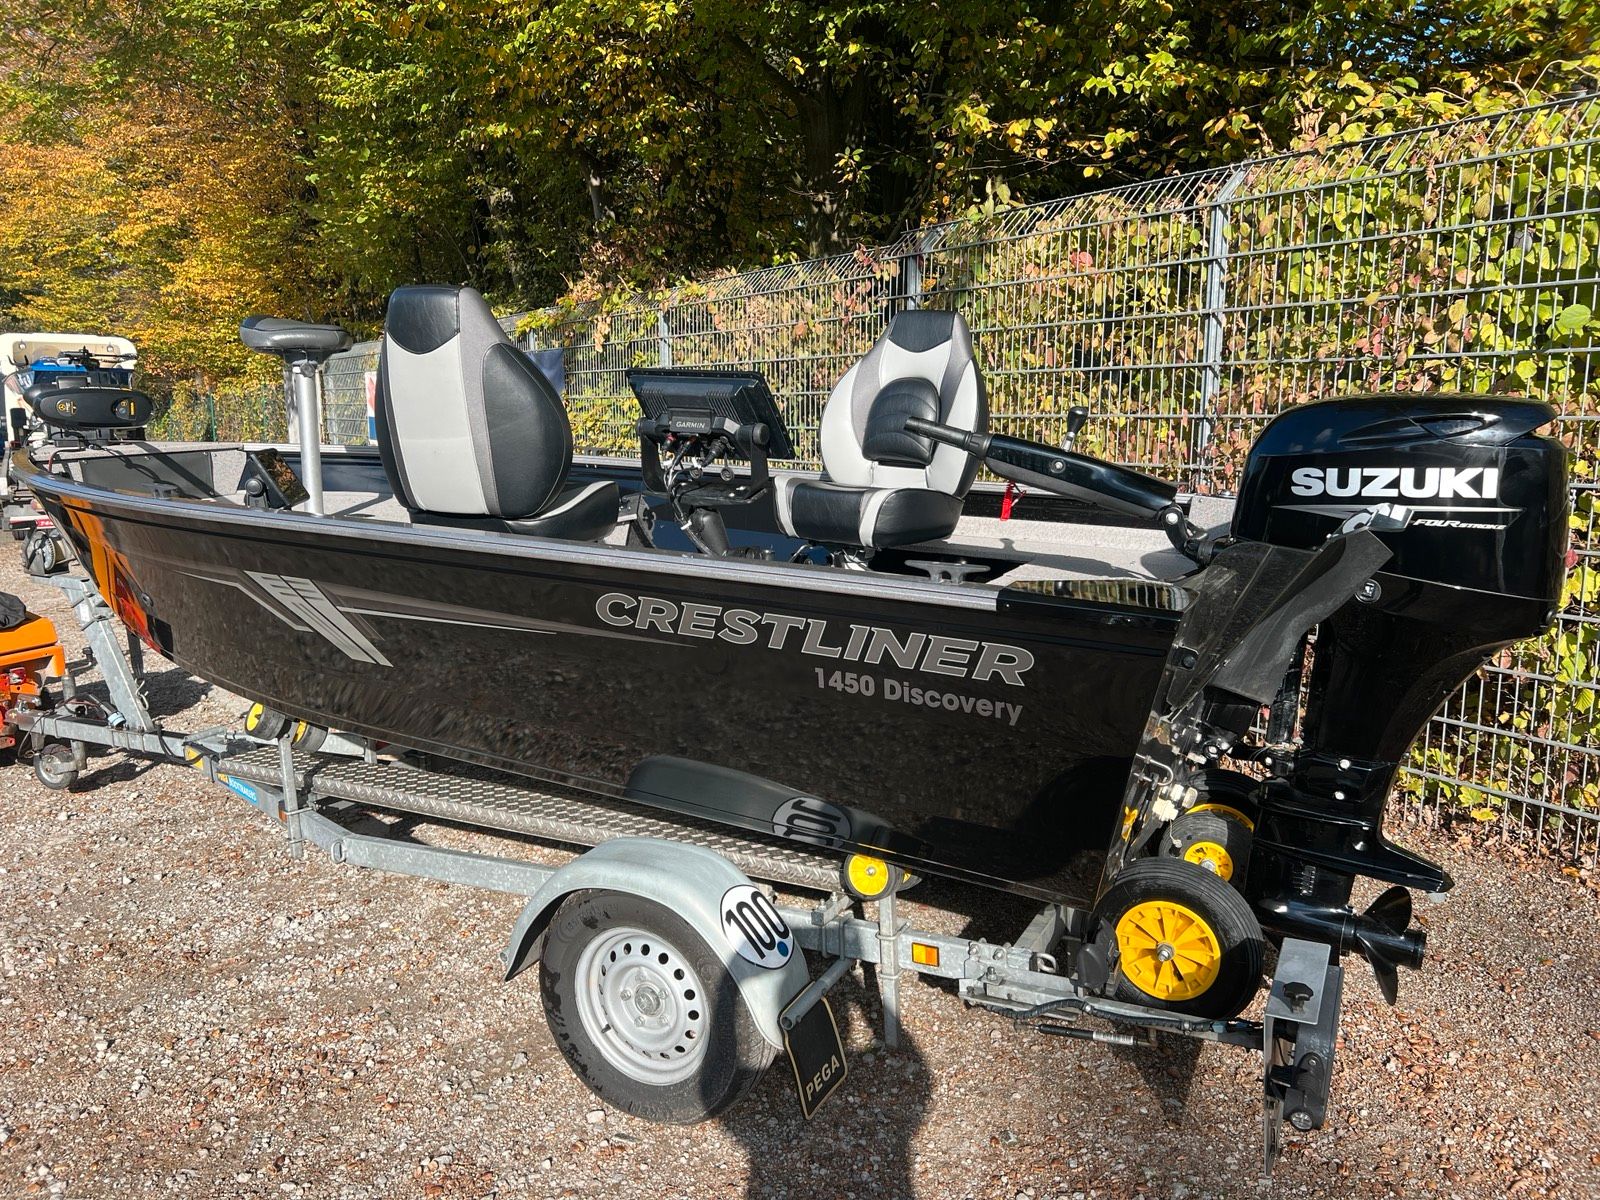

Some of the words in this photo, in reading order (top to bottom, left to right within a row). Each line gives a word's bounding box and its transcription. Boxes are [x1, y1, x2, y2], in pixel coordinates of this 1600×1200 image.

[675, 421, 706, 429] GARMIN
[1291, 467, 1499, 499] SUZUKI
[595, 592, 1035, 687] CRESTLINER
[814, 667, 875, 698] 1450
[883, 678, 1023, 727] Discovery
[725, 890, 790, 960] 100
[806, 1054, 840, 1102] PEGA
